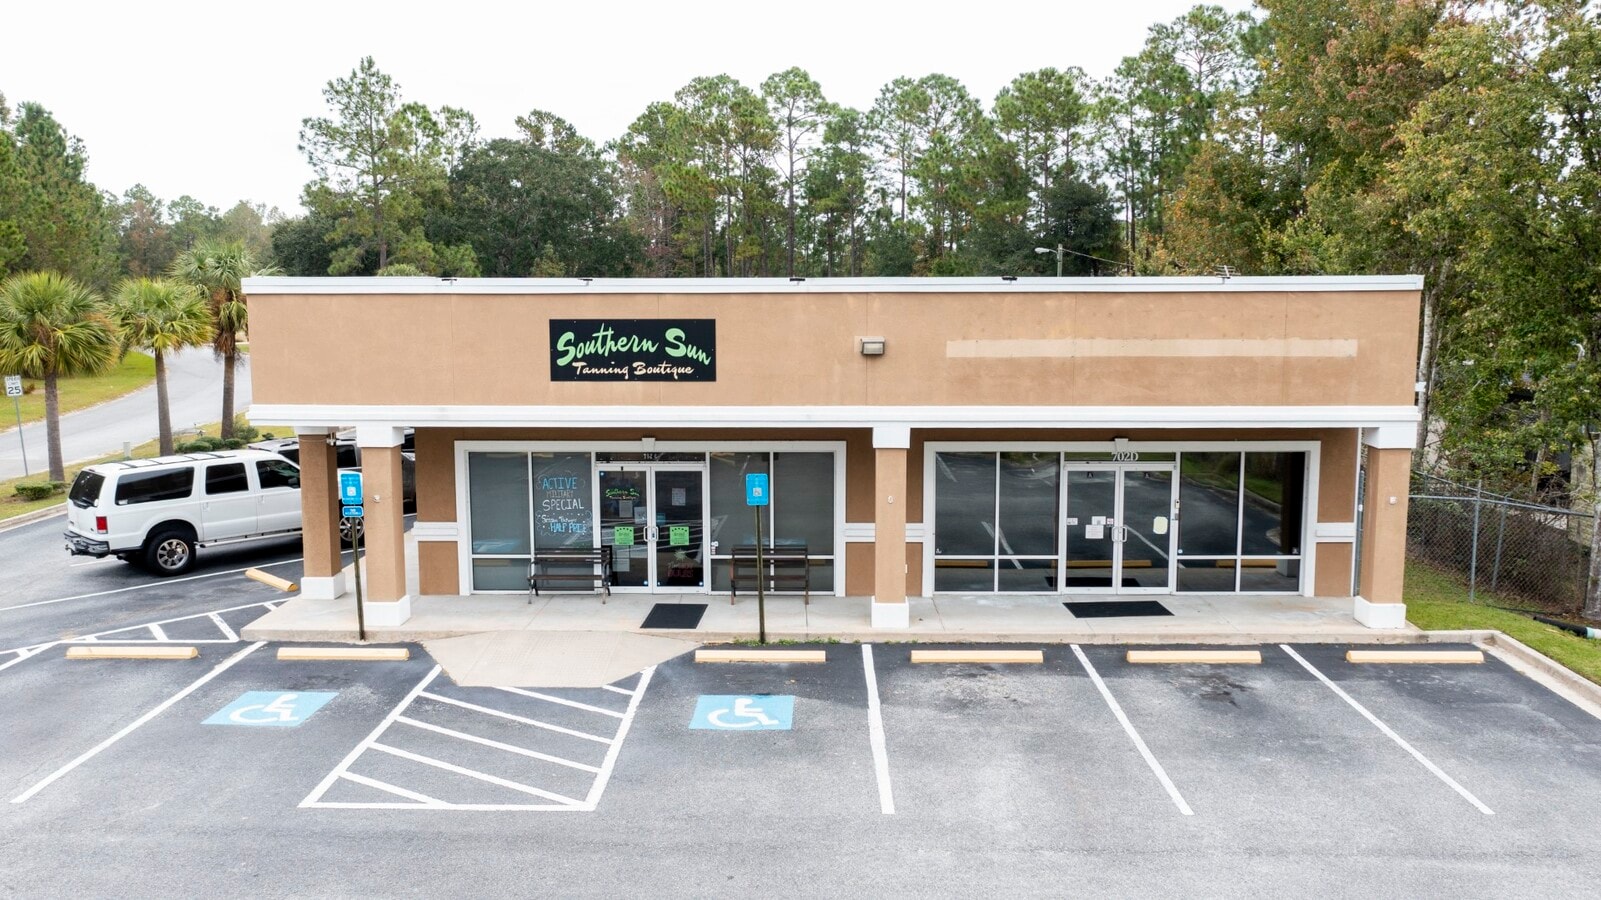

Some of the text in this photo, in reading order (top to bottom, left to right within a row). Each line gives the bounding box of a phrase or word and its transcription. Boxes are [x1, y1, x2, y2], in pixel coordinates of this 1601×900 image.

[556, 322, 712, 367] Southern Sun
[571, 360, 695, 380] Tanning Boutique
[8, 386, 21, 394] 25
[1111, 451, 1139, 461] 702D
[542, 476, 578, 490] ACTIVE
[542, 498, 585, 511] SPECIAL
[550, 522, 567, 532] HALF
